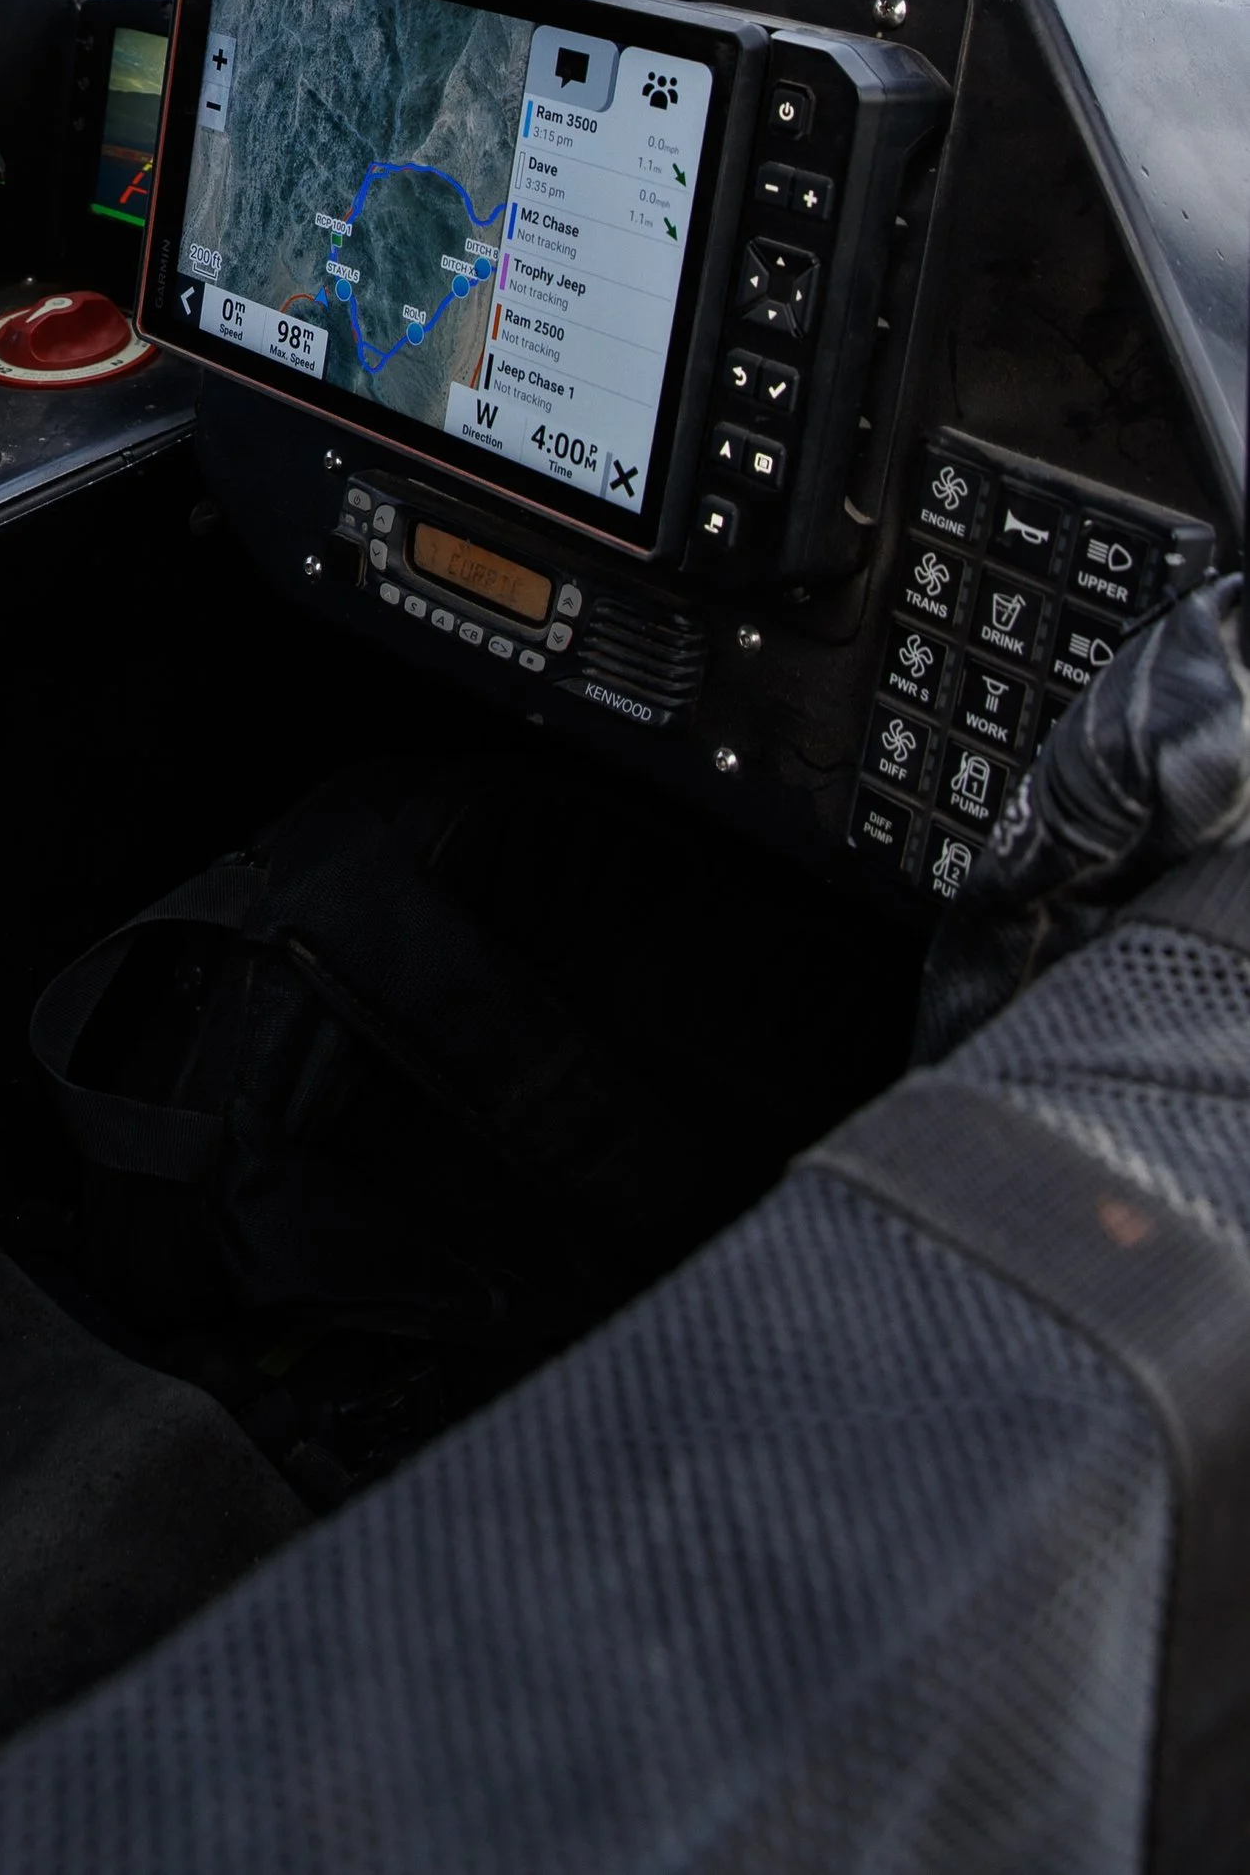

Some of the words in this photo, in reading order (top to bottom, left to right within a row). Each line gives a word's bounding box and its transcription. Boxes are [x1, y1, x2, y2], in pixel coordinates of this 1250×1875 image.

[536, 105, 563, 125] Ram
[566, 113, 598, 134] 3500
[533, 126, 555, 143] 3:15
[556, 134, 573, 148] pm
[528, 156, 558, 177] Dave
[525, 177, 547, 194] 3:35
[549, 186, 565, 200] pm
[316, 214, 332, 228] RCP
[520, 207, 540, 225] M2
[542, 214, 580, 237] Chase
[190, 244, 210, 265] 200
[211, 251, 223, 270] ft
[465, 240, 492, 257] DITCH
[517, 229, 536, 245] Not
[537, 234, 578, 260] tracking
[155, 238, 172, 309] GARMIN
[327, 262, 348, 278] STAY
[442, 256, 468, 273] DITCH
[514, 257, 554, 286] Trophy
[556, 274, 586, 297] Jeep
[509, 279, 528, 295] Not
[529, 285, 569, 312] tracking
[403, 307, 420, 321] ROL
[504, 308, 531, 330] Ram
[534, 319, 565, 341] 2500
[219, 323, 243, 342] Speed
[277, 320, 302, 350] 98
[501, 329, 519, 346] Not
[521, 335, 561, 363] tracking
[269, 344, 289, 362] Max.
[290, 353, 316, 372] Speed
[497, 360, 526, 381] Jeep
[528, 371, 565, 396] Chase
[568, 386, 575, 400] 1
[493, 378, 511, 395] Not
[513, 386, 553, 414] tracking
[476, 398, 499, 429] W
[462, 423, 503, 451] Direction
[531, 424, 586, 466] 4:00
[548, 459, 573, 479] Time
[920, 508, 967, 538] ENGINE
[1077, 570, 1129, 604] UPPER
[410, 601, 418, 613] S
[905, 588, 949, 619] TRANS
[435, 615, 446, 627] A
[981, 625, 1025, 656] DRINK
[1053, 658, 1092, 687] FRON
[584, 682, 653, 723] KENWOOD
[888, 672, 918, 698] PWR
[919, 686, 931, 704] S
[965, 710, 1010, 744] WORK
[878, 757, 908, 782] DIFF
[971, 780, 979, 794] 1
[949, 791, 991, 821] PUMP
[863, 821, 894, 846] PUMP
[868, 810, 894, 832] DIFF
[951, 866, 961, 882] 2
